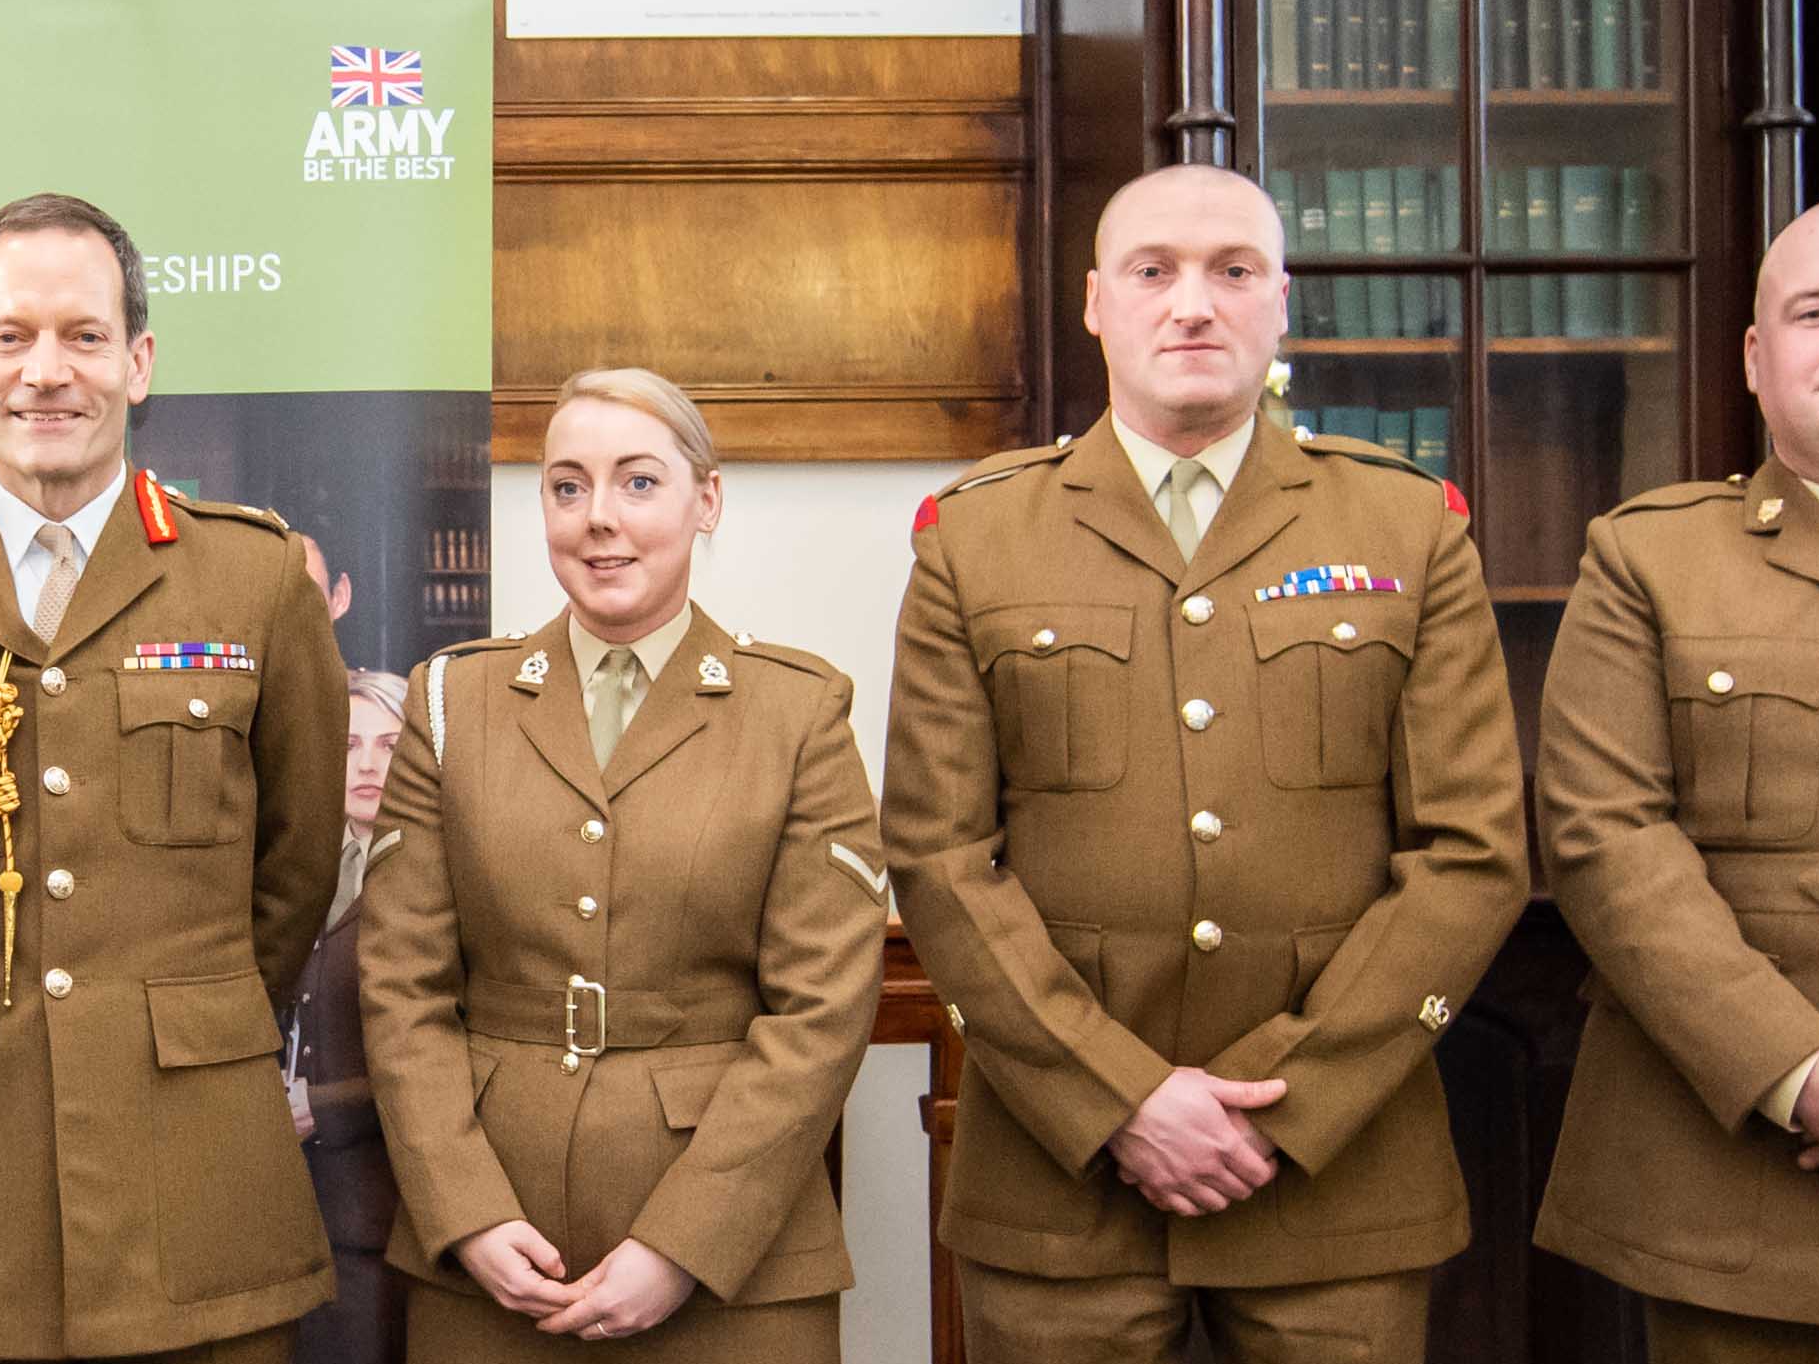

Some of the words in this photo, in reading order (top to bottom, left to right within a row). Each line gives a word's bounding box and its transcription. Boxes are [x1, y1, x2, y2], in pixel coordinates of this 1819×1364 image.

[304, 109, 455, 158] ARMY
[303, 159, 334, 182] BE
[339, 158, 388, 181] THE
[395, 156, 455, 180] BEST
